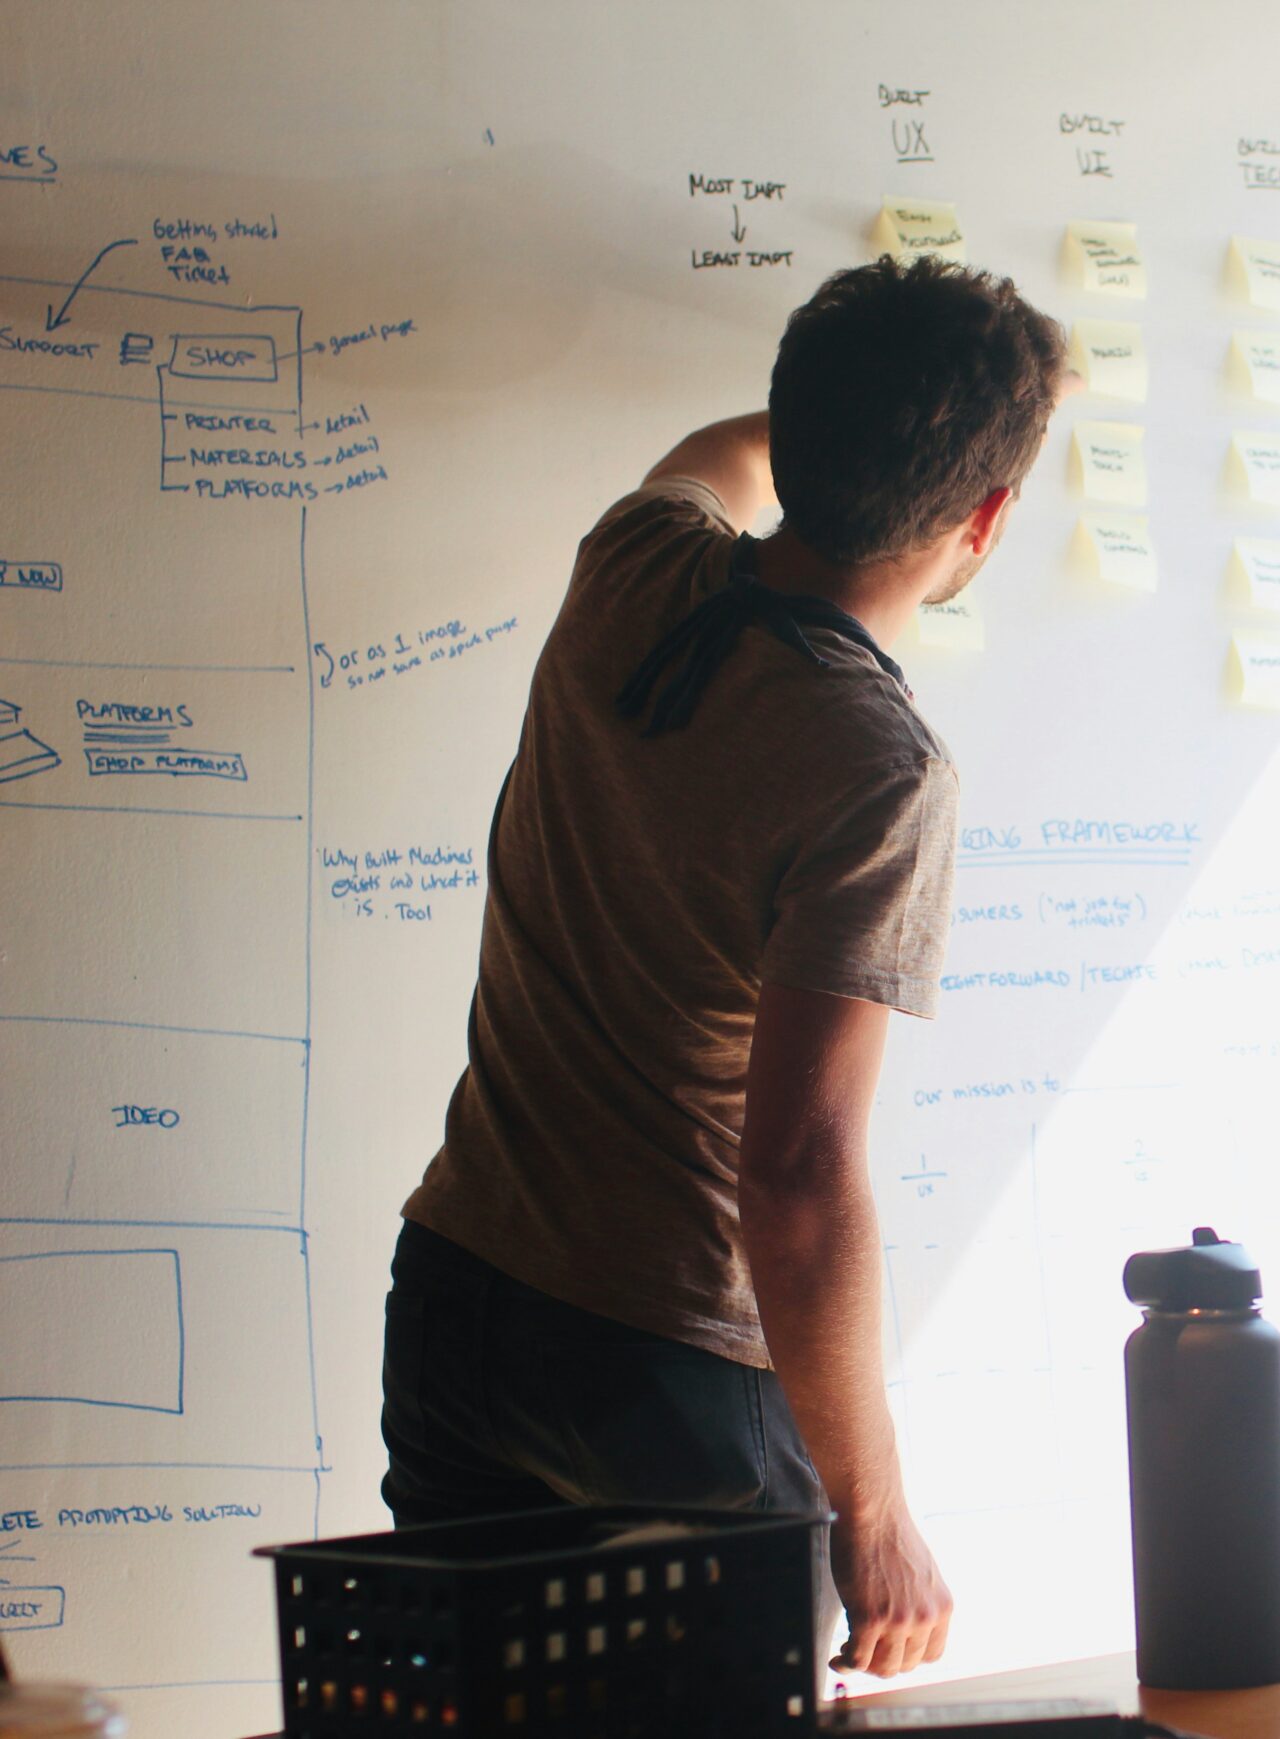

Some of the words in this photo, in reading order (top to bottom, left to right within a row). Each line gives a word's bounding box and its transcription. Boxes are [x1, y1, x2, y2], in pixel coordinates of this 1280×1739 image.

[1059, 113, 1125, 136] BUILT
[892, 119, 929, 155] UX
[741, 179, 786, 200] IMPT
[153, 217, 217, 242] Getting
[692, 249, 740, 269] LEAST
[748, 250, 793, 267] IMPT
[186, 346, 256, 368] SHOP
[185, 412, 277, 435] PRINTER
[190, 447, 307, 469] MATERIALS
[335, 435, 379, 464] detail
[195, 478, 319, 501] PLATFORMS
[339, 650, 359, 670] or
[367, 644, 387, 661] as
[418, 619, 466, 646] image
[76, 699, 194, 727] PLATFORMS
[155, 755, 241, 774] PLATFORMS
[1040, 818, 1201, 846] FRAMEWORK
[322, 846, 359, 873] Why
[365, 849, 403, 869] Built
[408, 845, 474, 867] Machines
[394, 902, 432, 921] Tool
[952, 1081, 1015, 1100] mission
[1020, 1078, 1036, 1094] is
[111, 1104, 180, 1128] IDEO
